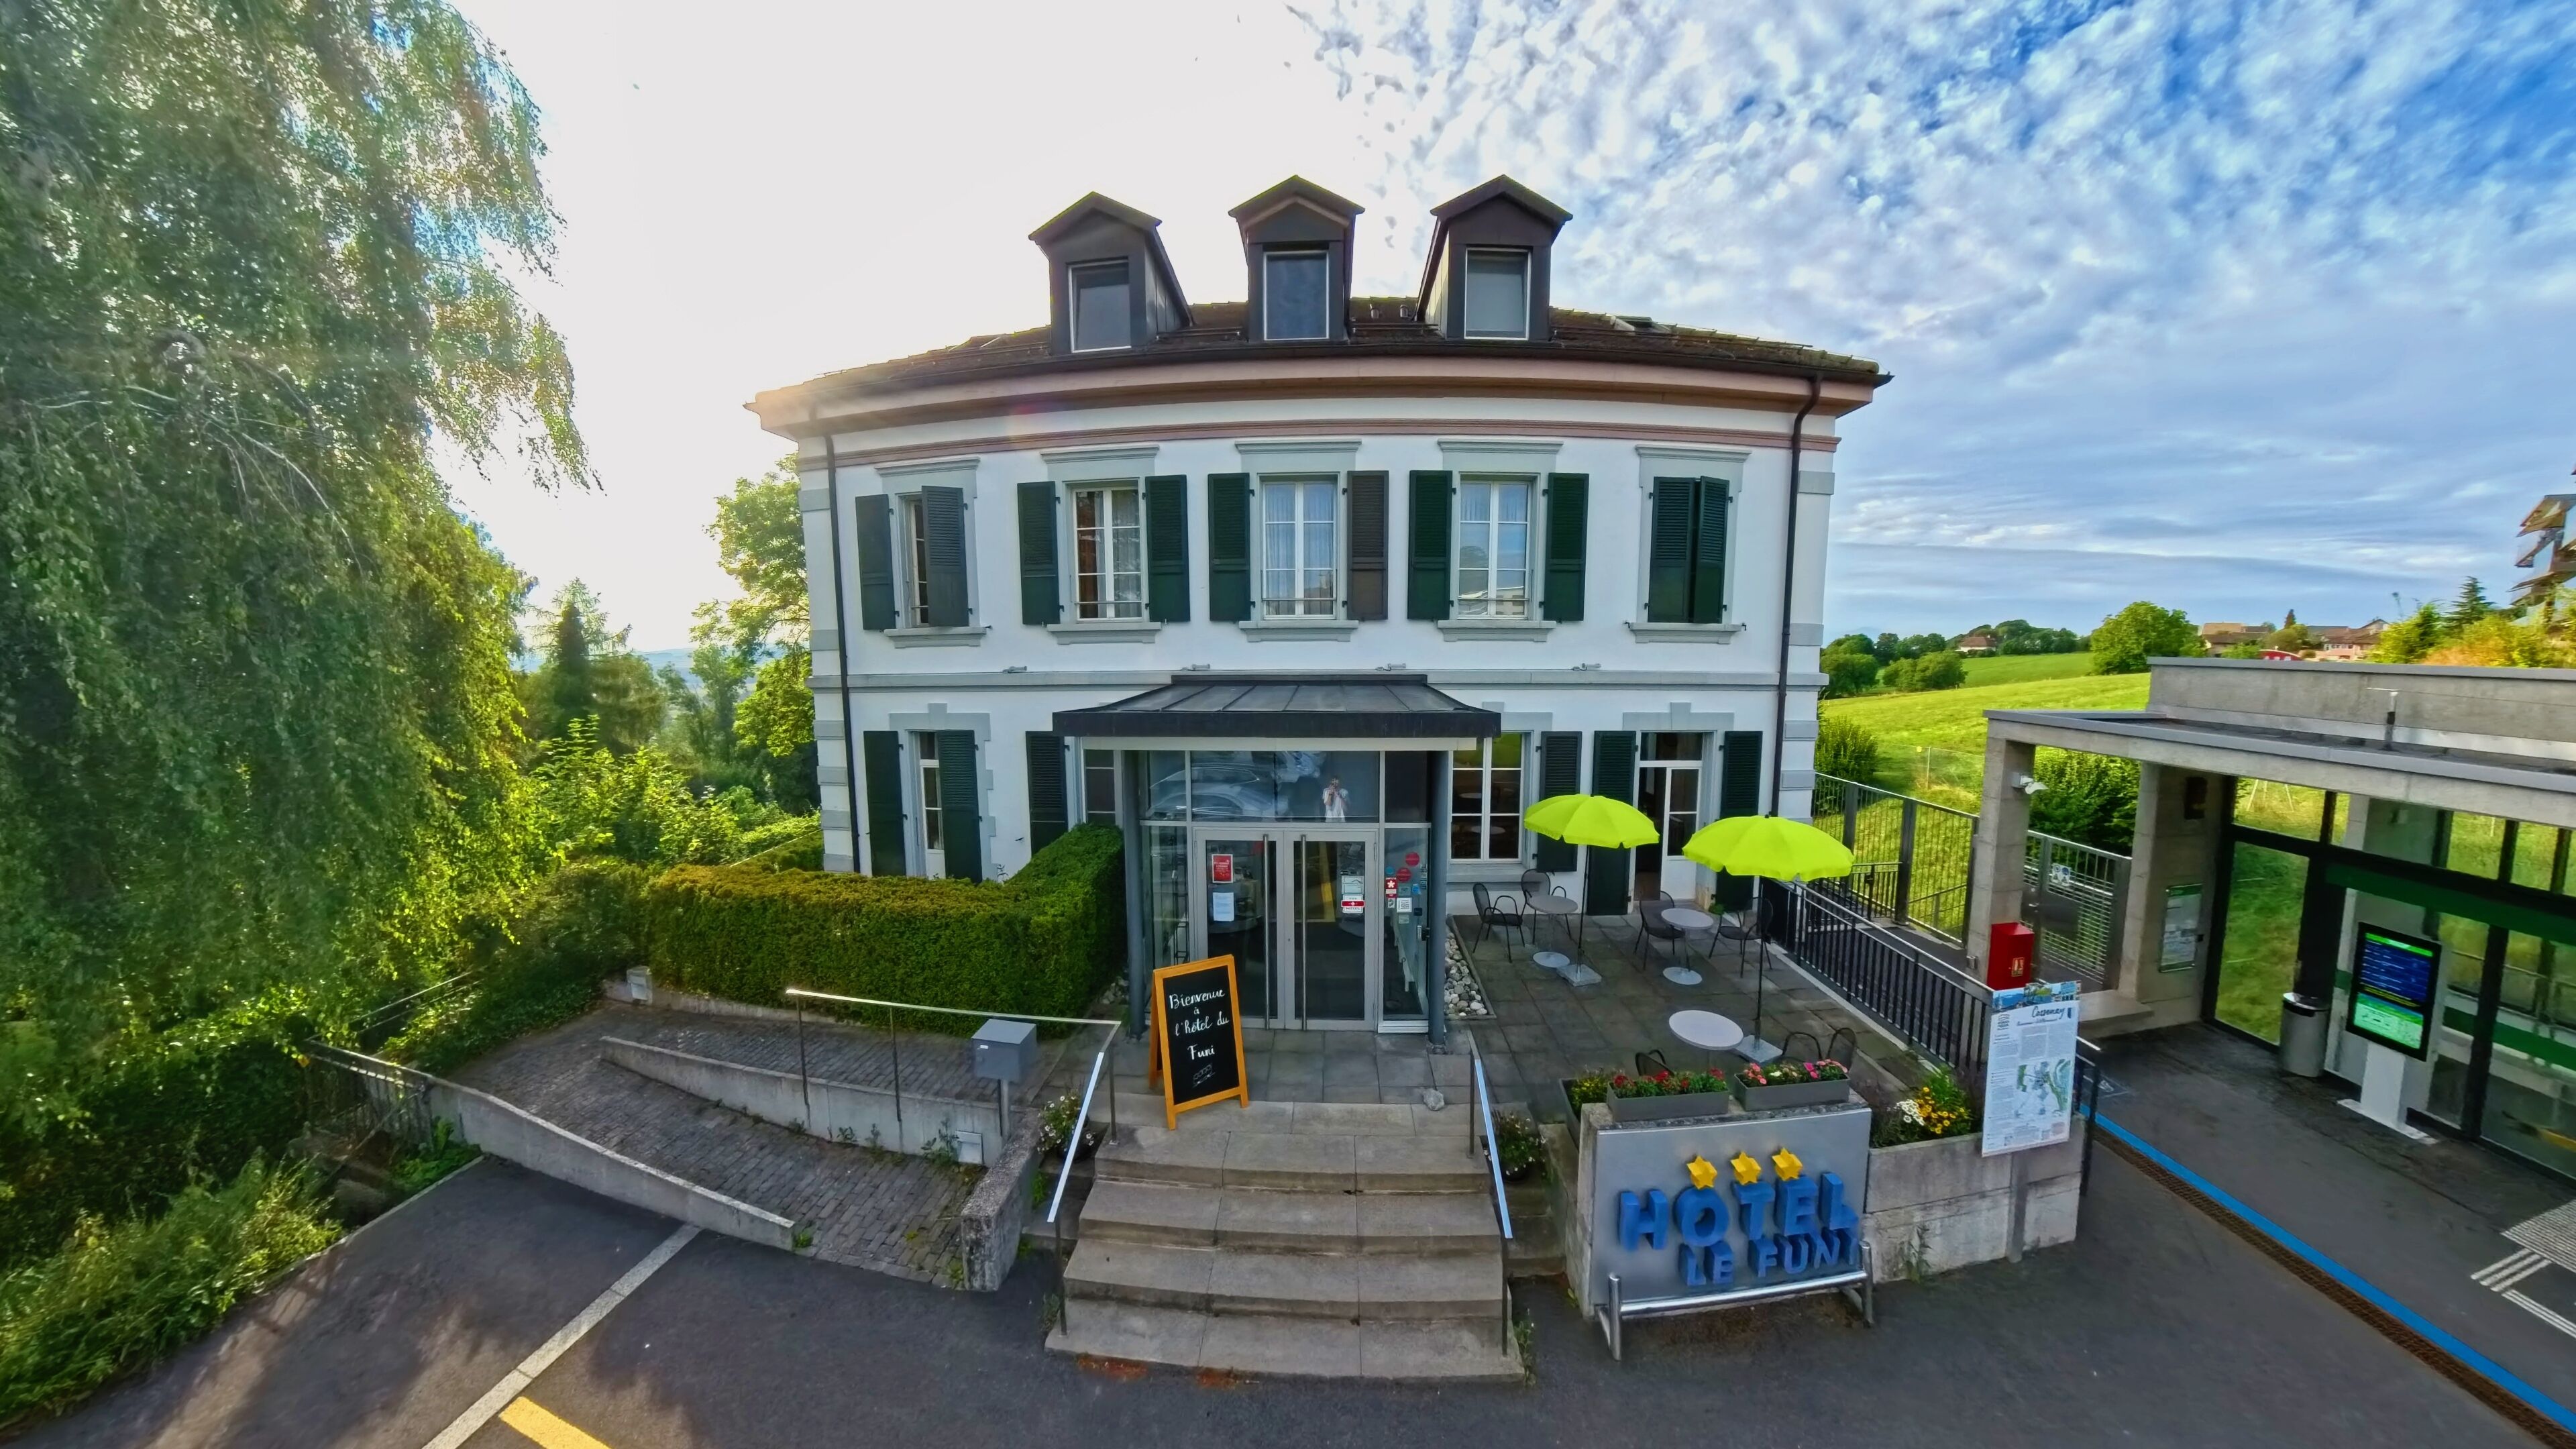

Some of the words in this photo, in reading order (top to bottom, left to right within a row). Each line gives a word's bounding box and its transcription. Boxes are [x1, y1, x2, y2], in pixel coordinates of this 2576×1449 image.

[1169, 989, 1225, 1009] Bienvenue
[1217, 1011, 1230, 1026] du
[1187, 1044, 1215, 1060] Funi
[1617, 1172, 1859, 1252] HOTEL
[1678, 1240, 1735, 1286] LE
[1748, 1227, 1858, 1278] FUNI
